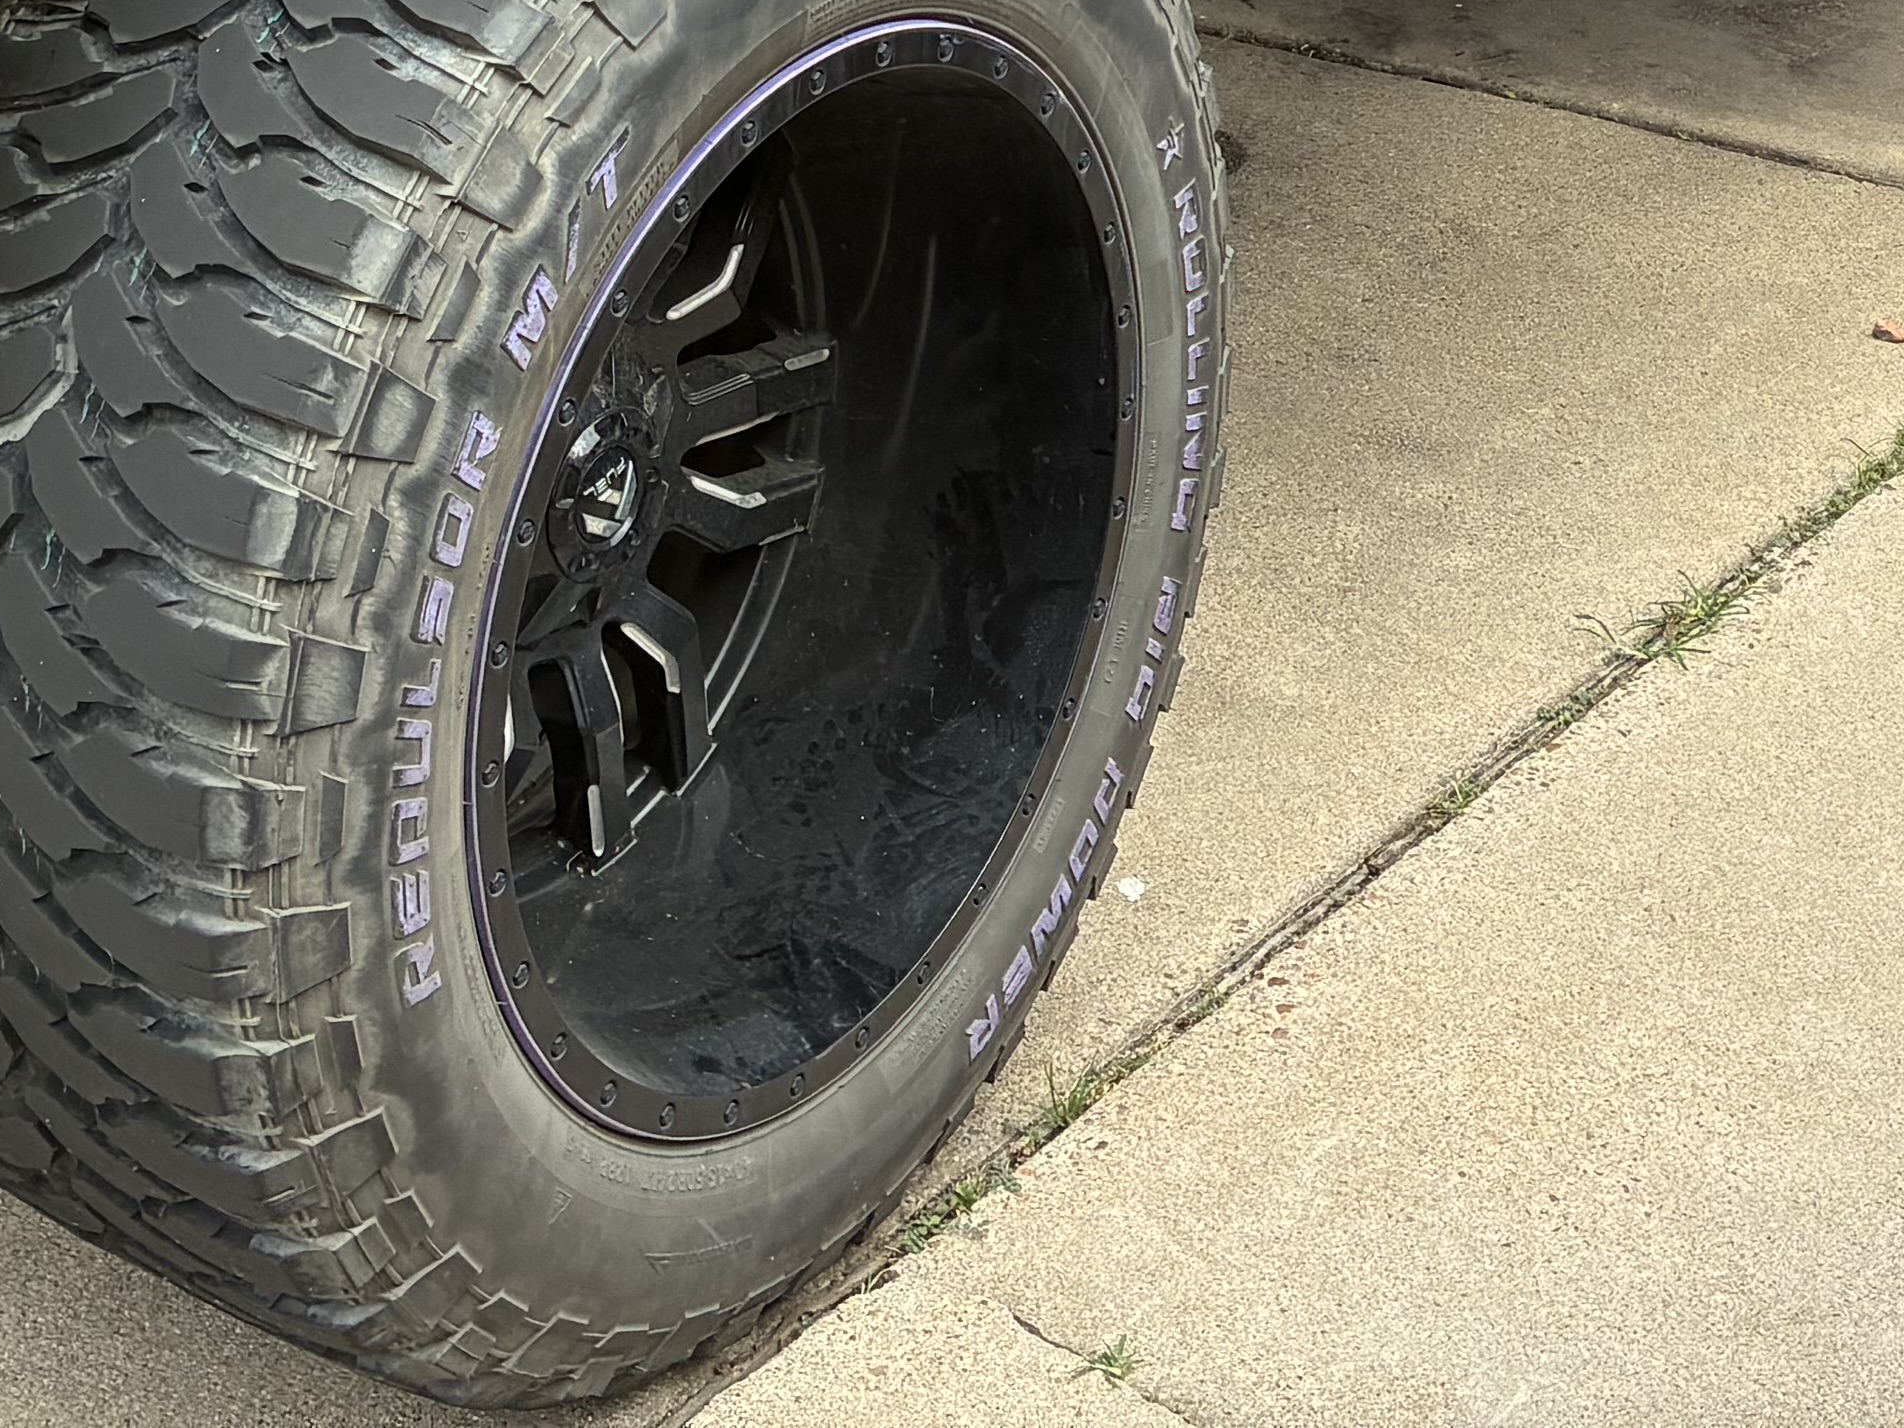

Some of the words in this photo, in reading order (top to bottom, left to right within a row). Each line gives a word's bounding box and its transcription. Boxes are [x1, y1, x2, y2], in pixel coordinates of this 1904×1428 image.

[1169, 180, 1208, 532] ROLLING
[583, 457, 626, 497] FUEL
[1124, 575, 1179, 724] BIG
[966, 755, 1124, 1062] POWER
